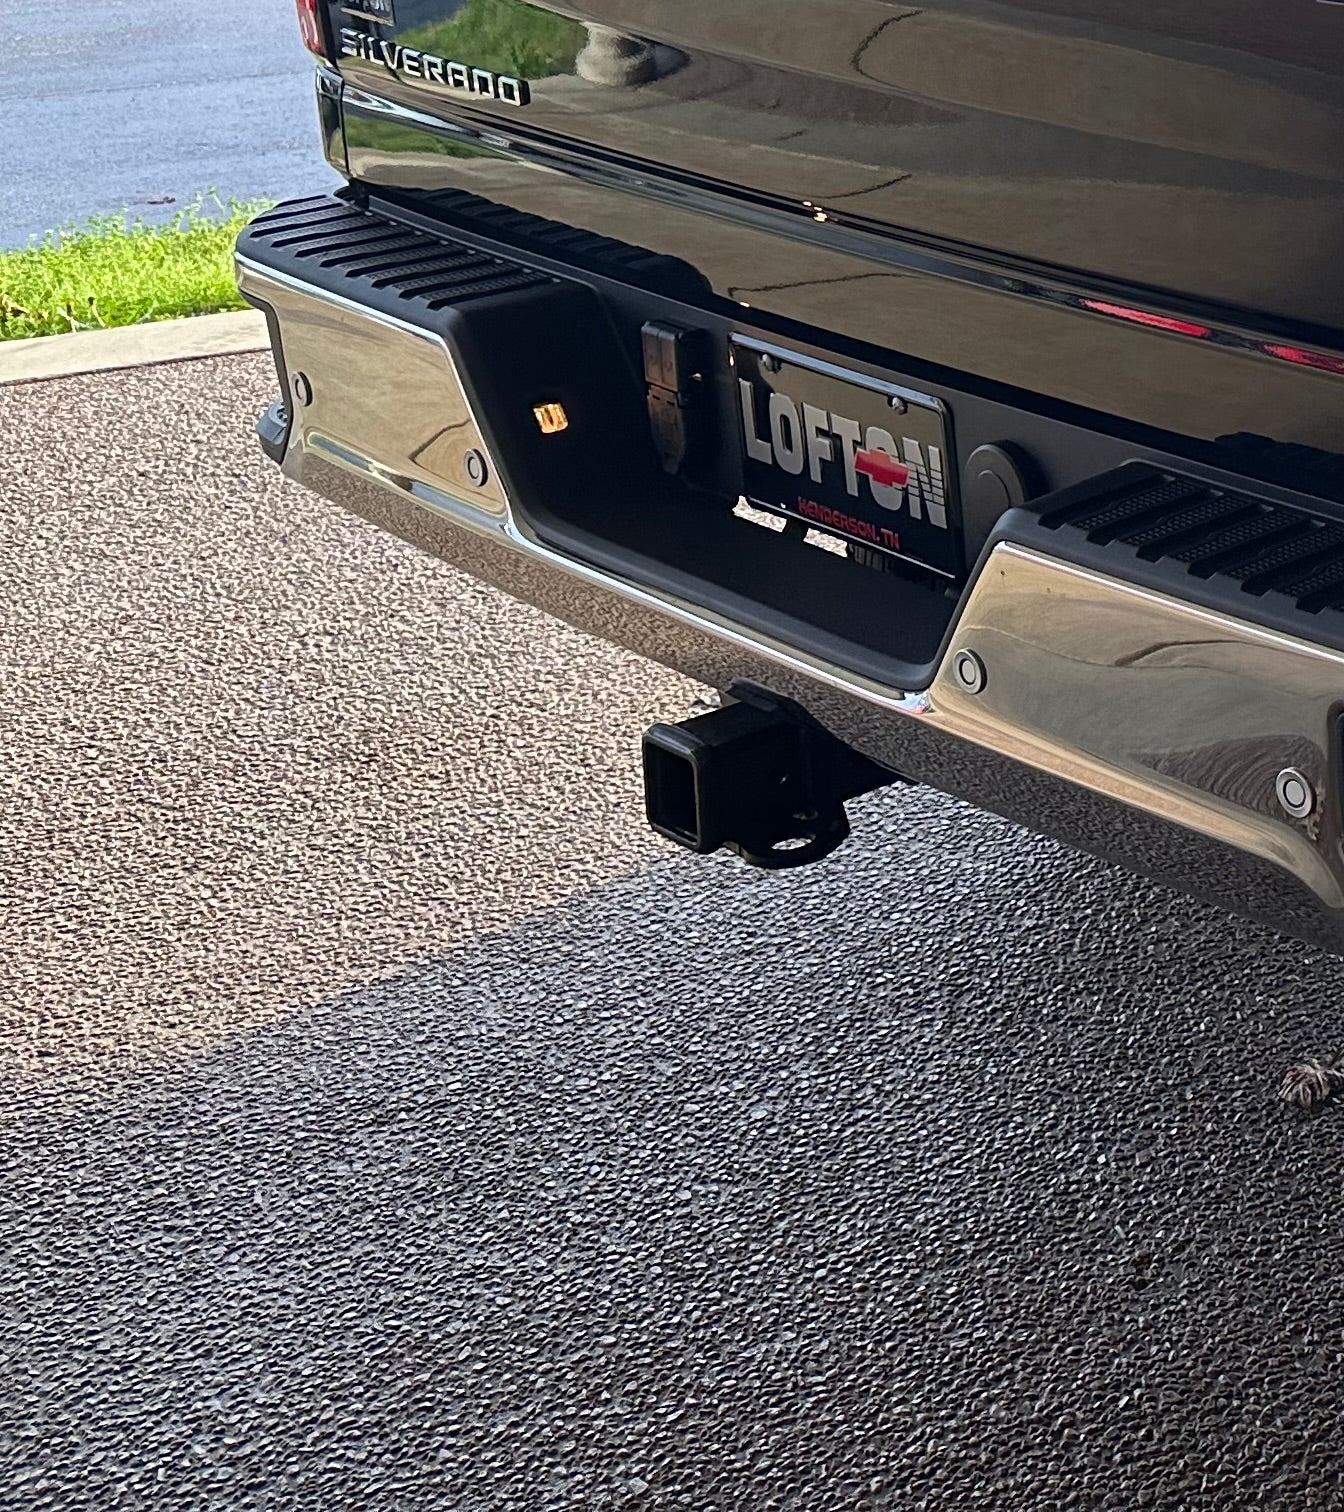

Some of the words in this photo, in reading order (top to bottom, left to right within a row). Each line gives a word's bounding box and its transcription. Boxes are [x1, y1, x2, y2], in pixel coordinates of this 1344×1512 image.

[340, 28, 531, 106] SILVERADO
[738, 377, 948, 530] LOFTON
[880, 527, 901, 552] TN
